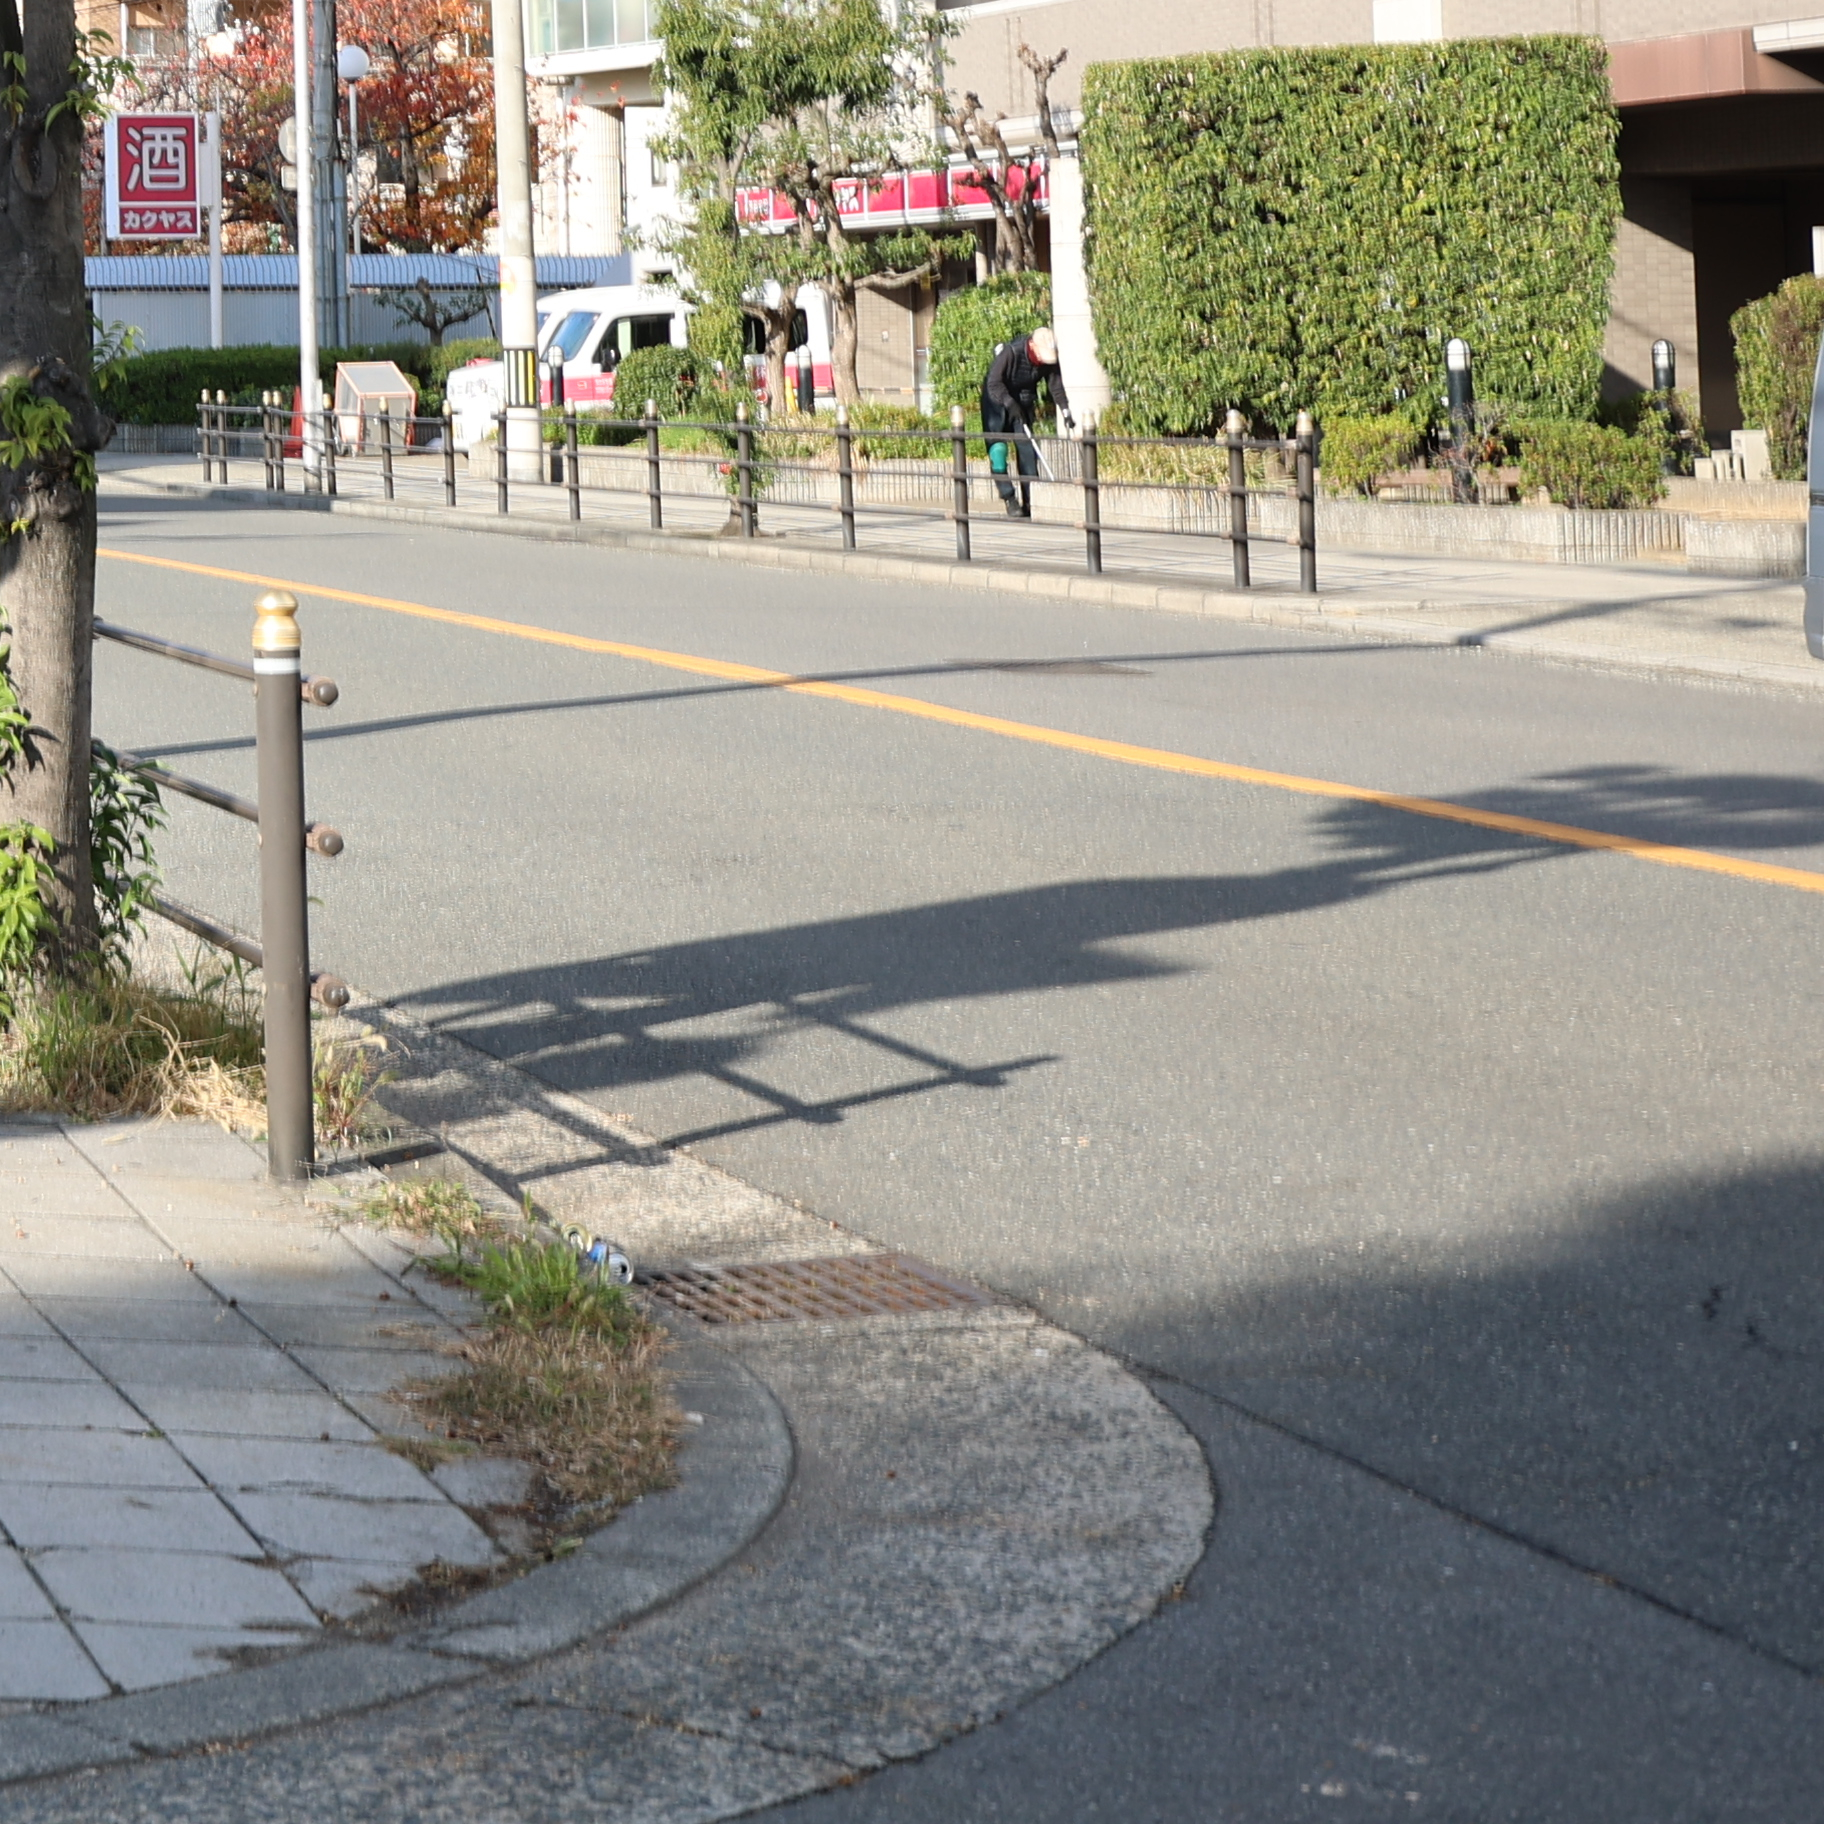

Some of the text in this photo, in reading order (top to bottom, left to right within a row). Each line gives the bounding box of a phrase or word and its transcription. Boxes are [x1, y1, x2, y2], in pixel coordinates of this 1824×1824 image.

[126, 126, 188, 192] 酒
[124, 209, 194, 230] カクヤス
